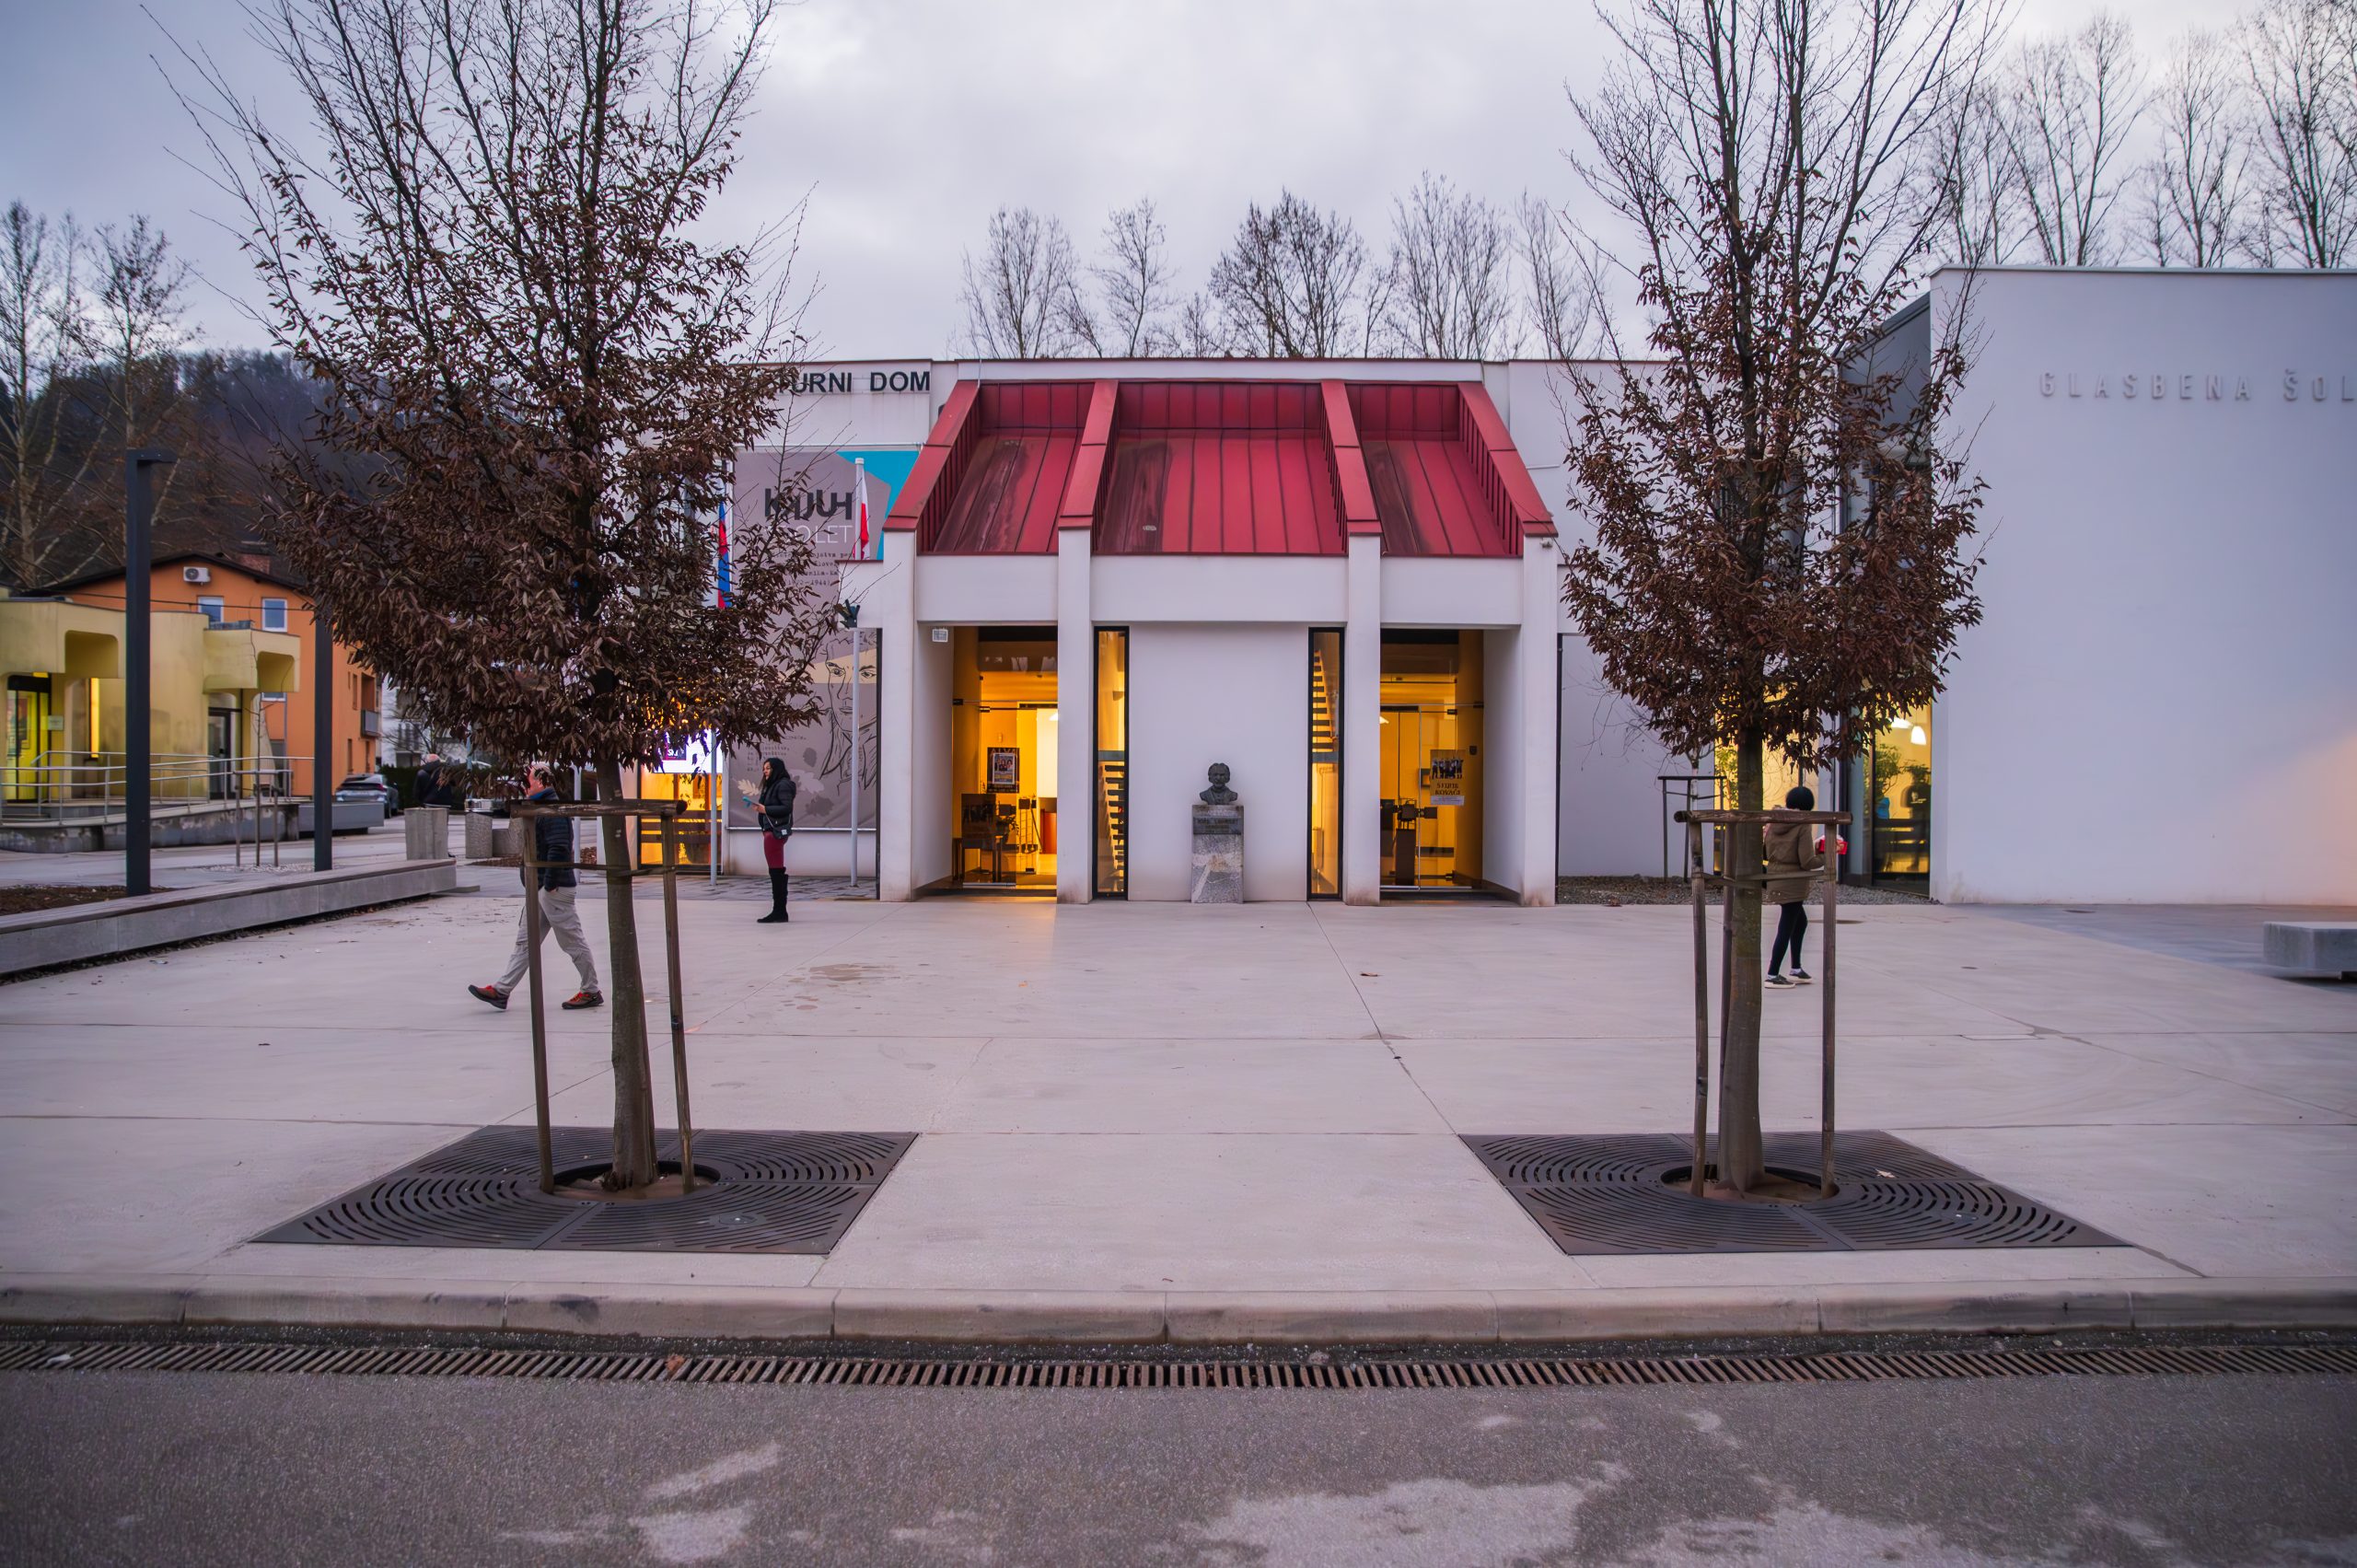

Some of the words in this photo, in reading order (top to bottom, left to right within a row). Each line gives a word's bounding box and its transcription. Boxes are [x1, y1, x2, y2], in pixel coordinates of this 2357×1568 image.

[780, 371, 853, 393] URNI
[870, 370, 930, 392] DOM
[2039, 372, 2251, 401] GLASBENA
